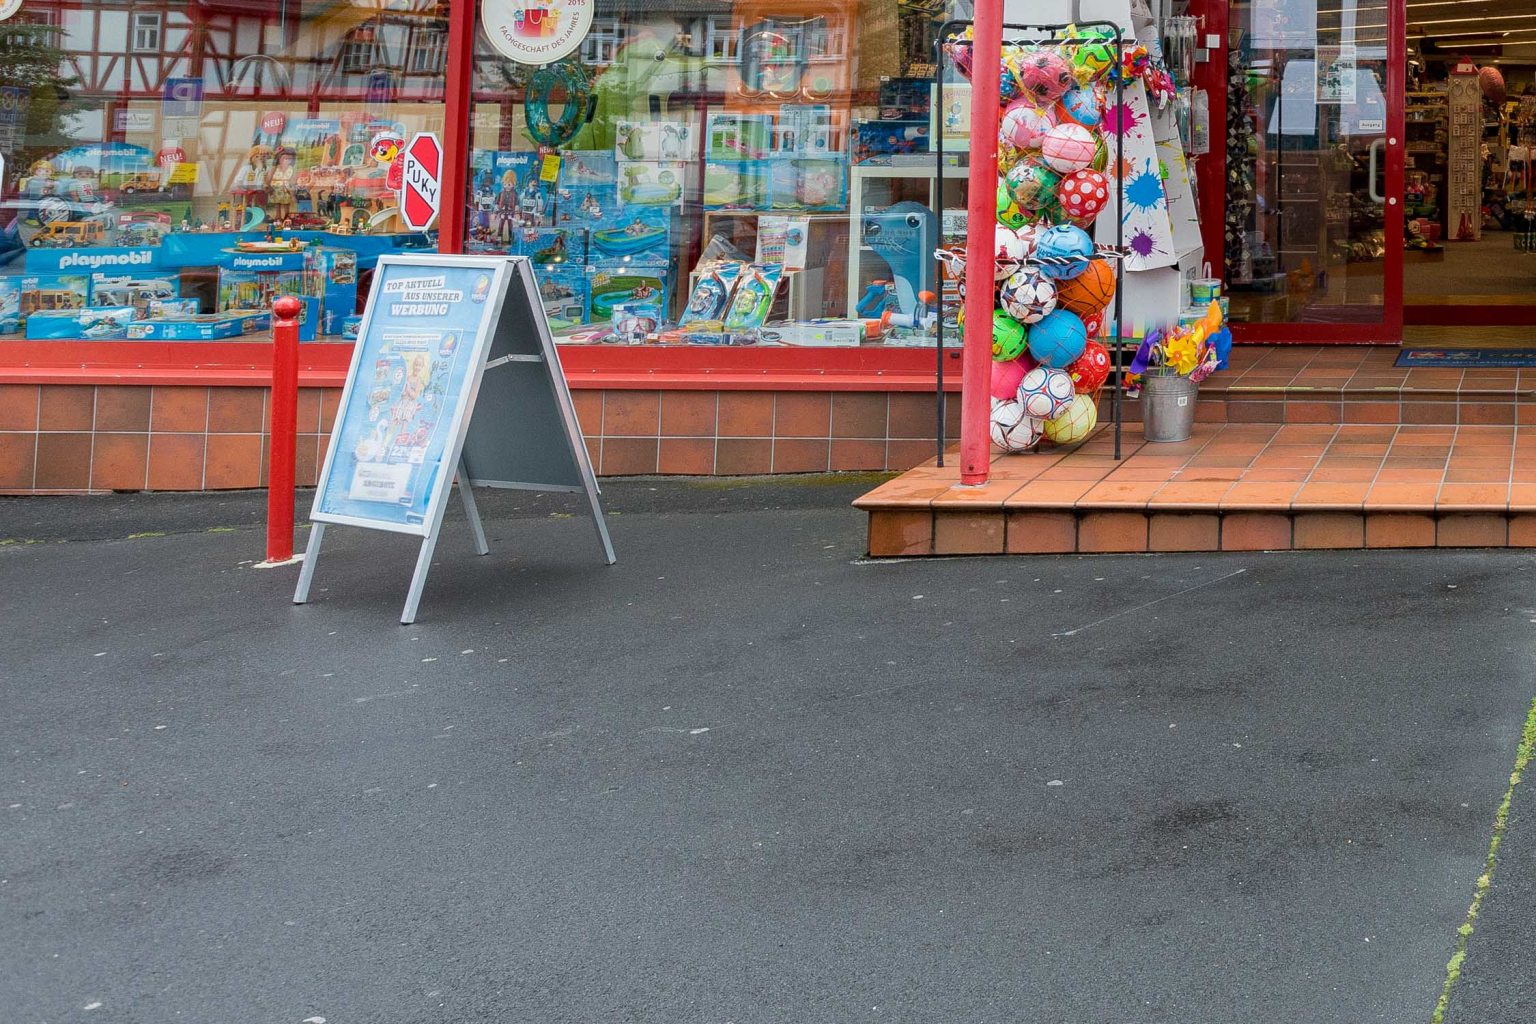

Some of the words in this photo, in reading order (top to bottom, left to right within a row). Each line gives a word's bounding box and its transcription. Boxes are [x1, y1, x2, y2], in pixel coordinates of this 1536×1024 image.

[552, 37, 566, 49] DES
[565, 11, 580, 39] JAHRES
[264, 117, 284, 128] NEU!
[159, 152, 183, 164] NEU!
[496, 156, 528, 166] playmobil
[407, 159, 438, 203] PUKY
[59, 250, 153, 270] playmobil
[233, 256, 283, 269] playmobil
[386, 281, 404, 290] TOP
[404, 279, 443, 290] AKTUELL
[404, 292, 420, 301] AUS
[421, 292, 461, 301] UNSERER
[391, 303, 449, 316] WERBUNG
